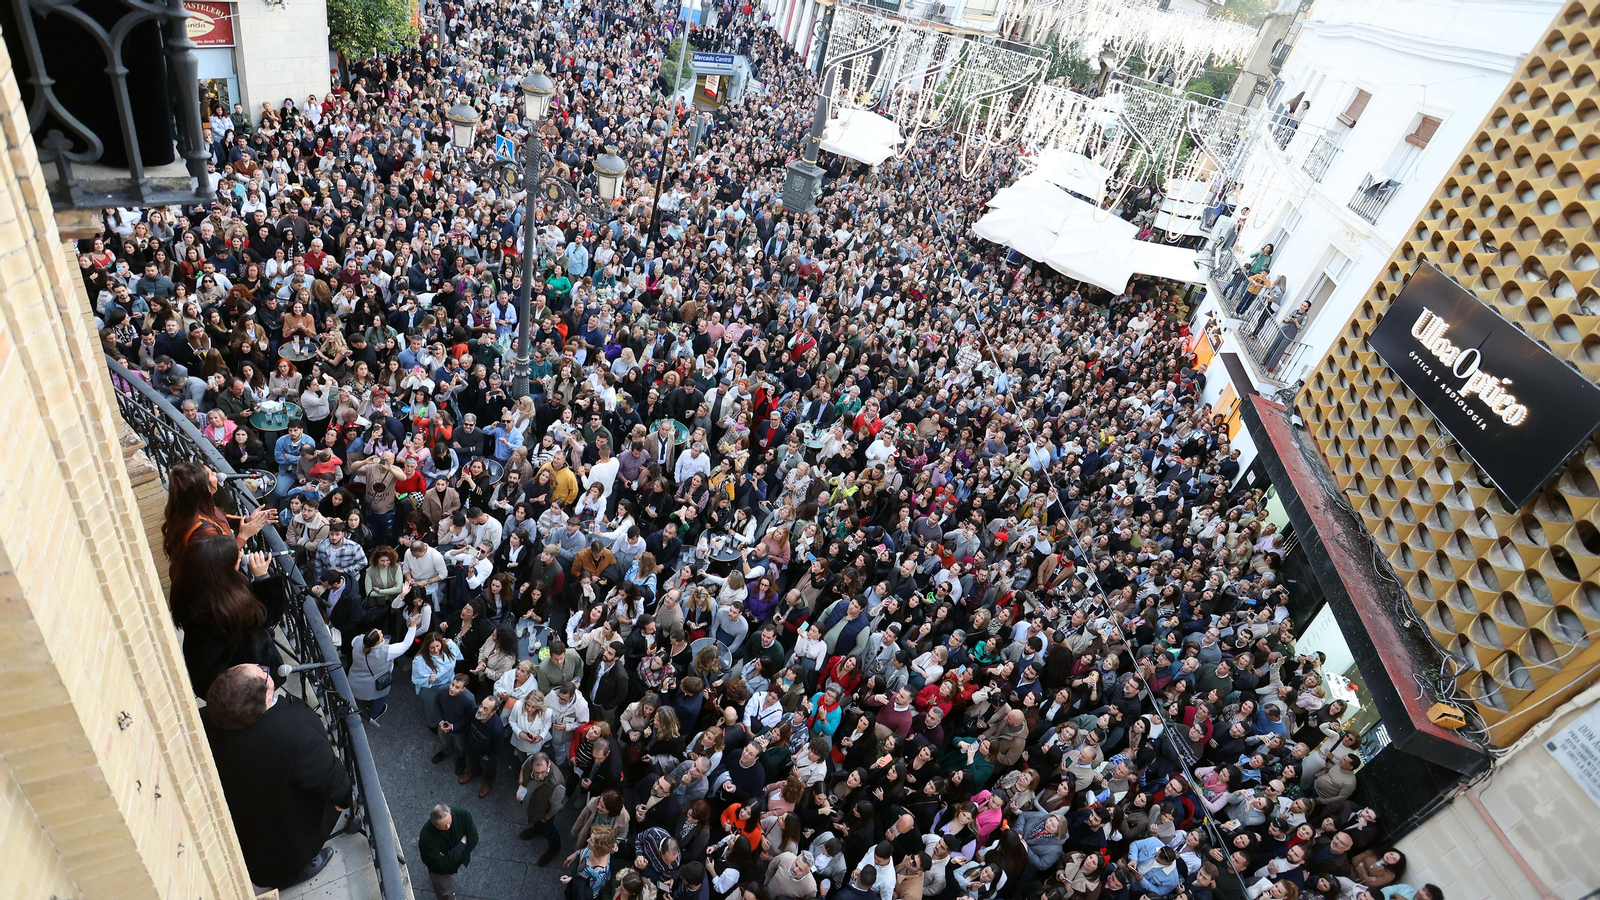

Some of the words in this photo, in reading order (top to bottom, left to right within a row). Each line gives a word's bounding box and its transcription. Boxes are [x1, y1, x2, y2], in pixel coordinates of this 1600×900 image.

[1408, 351, 1432, 376] ÓPTICA
[1440, 383, 1487, 431] AUDIOLOGÍA
[1567, 730, 1580, 743] PARA
[1578, 724, 1596, 741] DON
